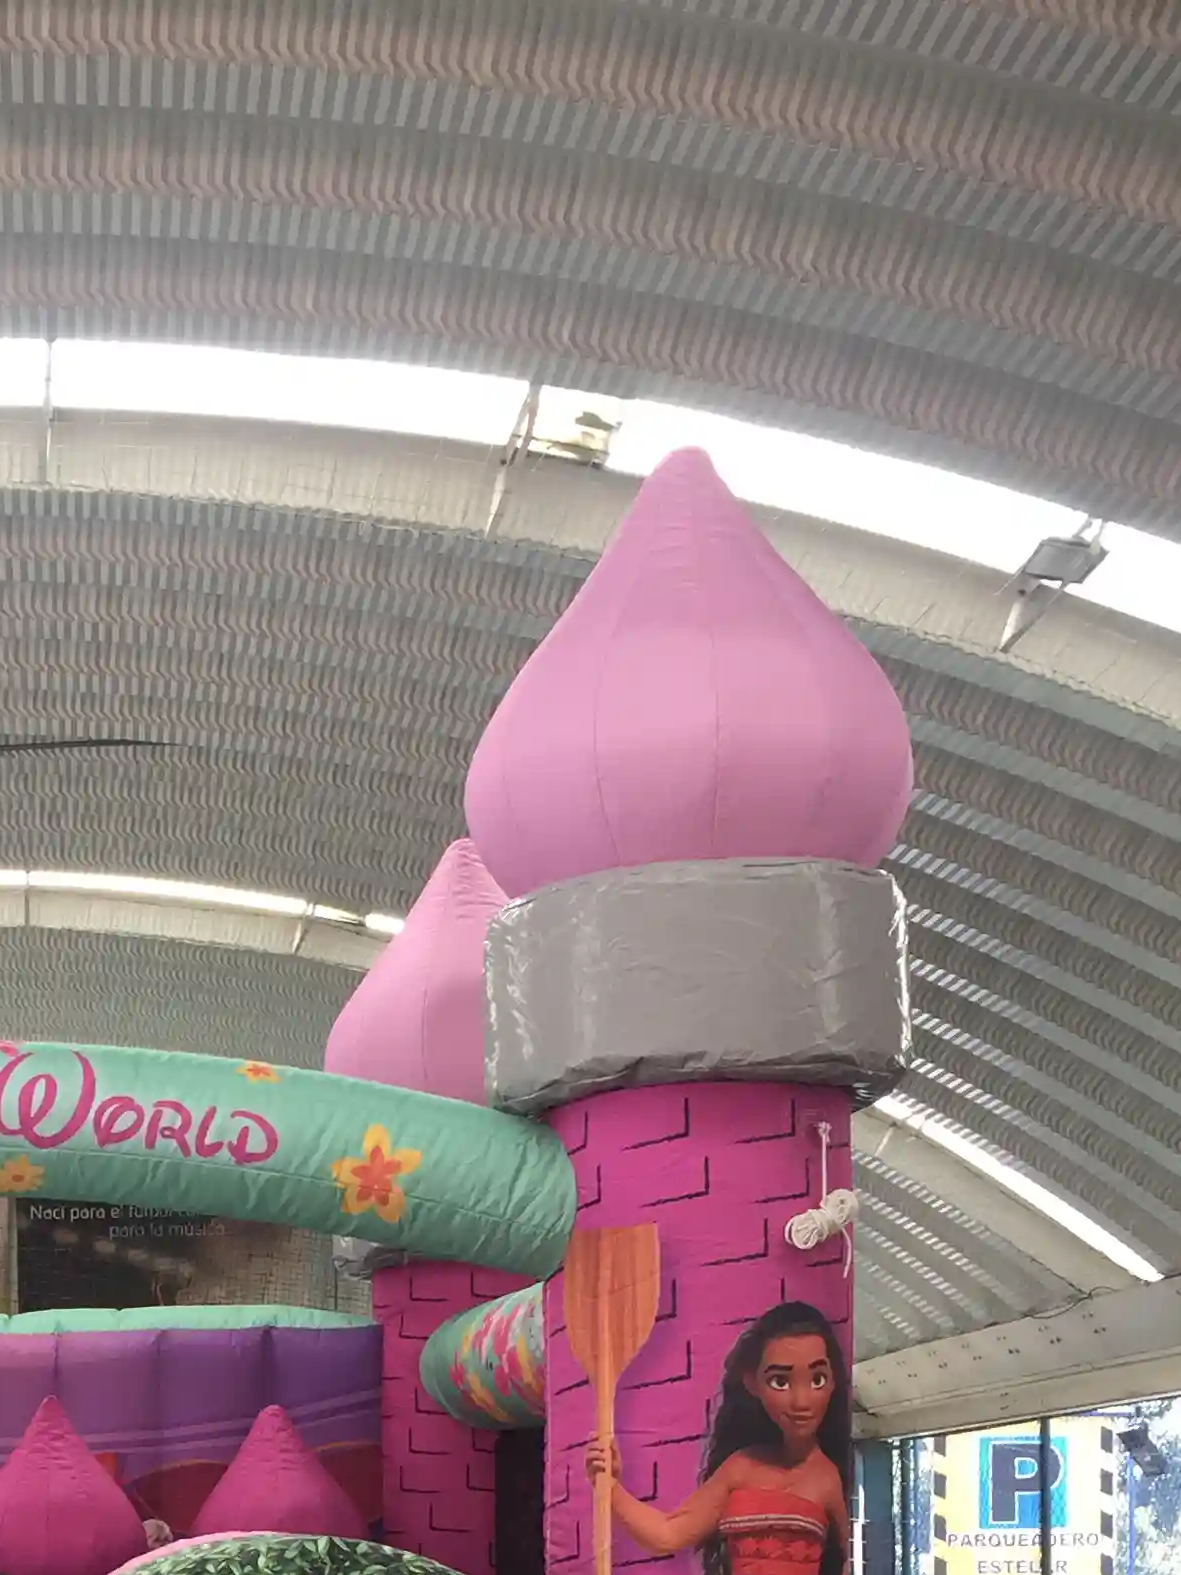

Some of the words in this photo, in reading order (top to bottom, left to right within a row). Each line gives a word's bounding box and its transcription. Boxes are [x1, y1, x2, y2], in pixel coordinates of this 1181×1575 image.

[70, 1207, 106, 1223] para
[109, 1224, 145, 1240] para
[989, 1440, 1063, 1525] P
[976, 1559, 1068, 1575] ESTELR
